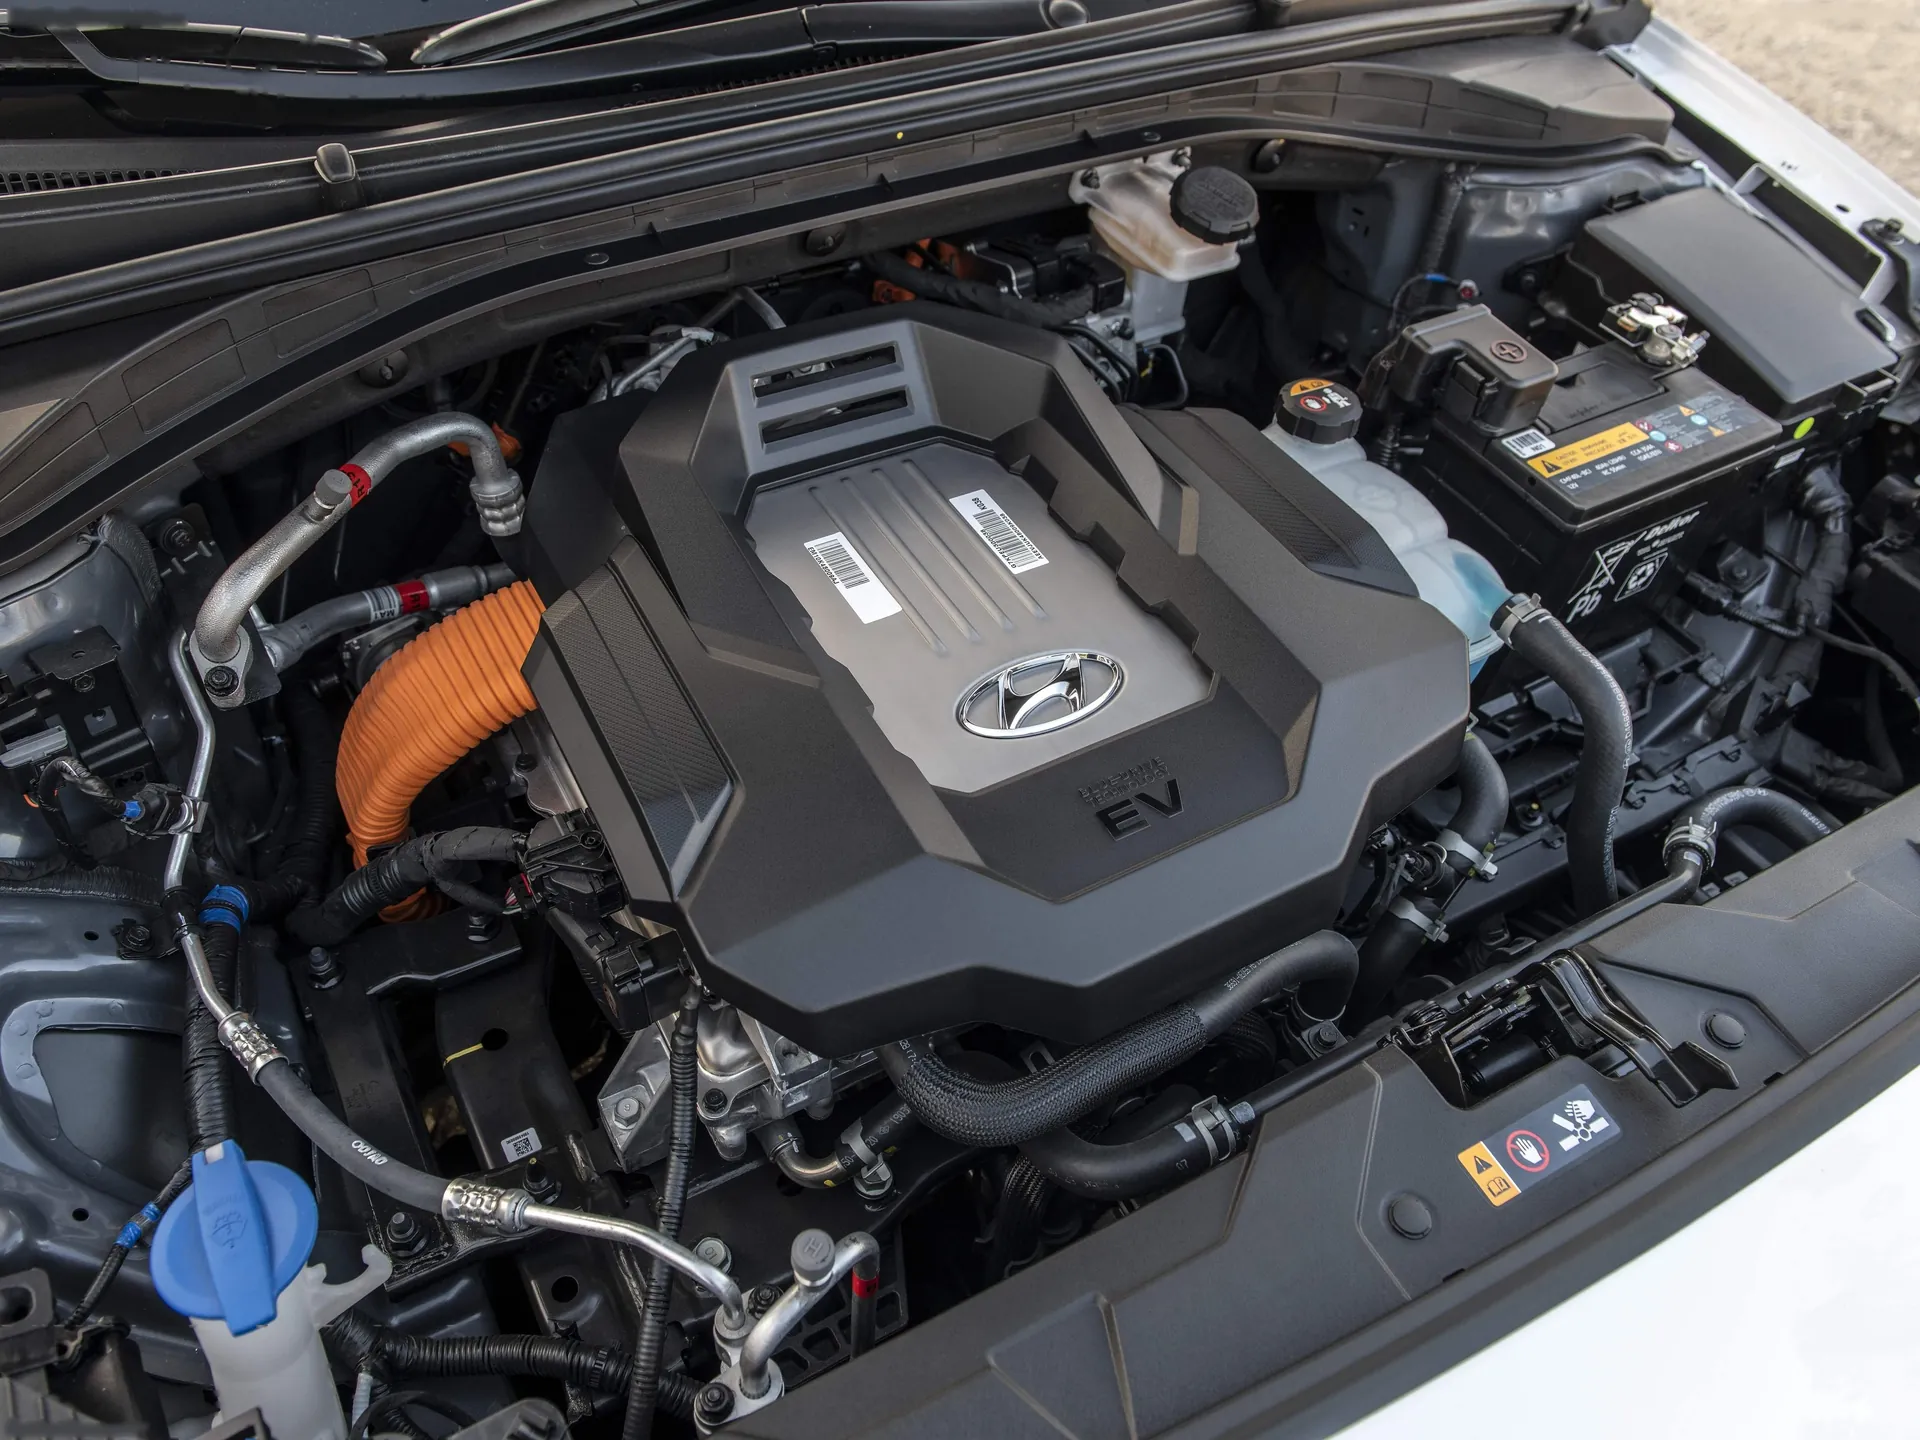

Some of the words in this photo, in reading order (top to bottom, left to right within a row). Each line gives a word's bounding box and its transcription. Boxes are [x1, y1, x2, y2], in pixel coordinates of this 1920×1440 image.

[1566, 591, 1603, 623] Pb
[1086, 765, 1170, 807] TECHNOLOGY
[1096, 779, 1184, 841] EV
